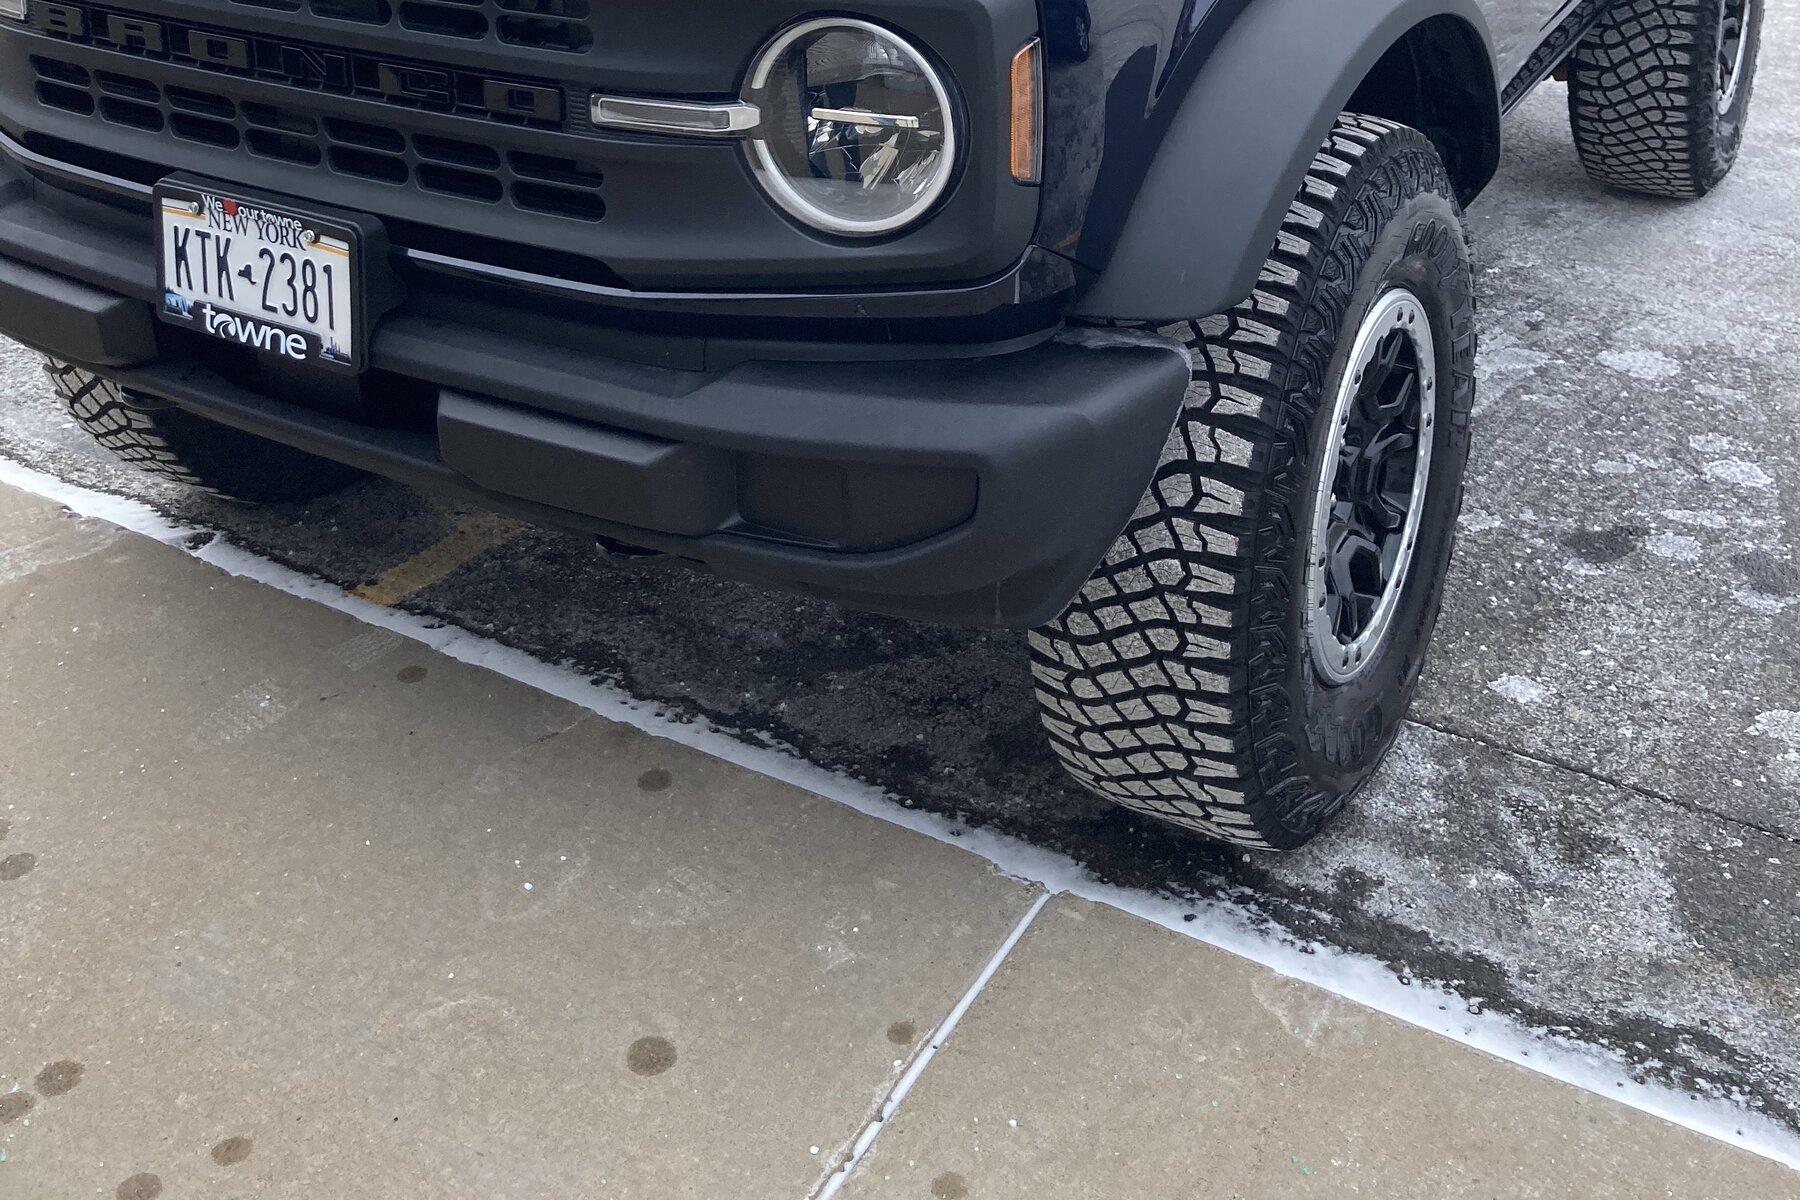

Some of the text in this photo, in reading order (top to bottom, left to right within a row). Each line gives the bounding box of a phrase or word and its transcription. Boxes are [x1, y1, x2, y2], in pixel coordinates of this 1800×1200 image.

[35, 0, 561, 123] BRONCO
[201, 193, 303, 230] We our towne
[208, 211, 307, 251] NEW YORK
[173, 225, 336, 330] KTK 2381
[202, 303, 307, 360] towne
